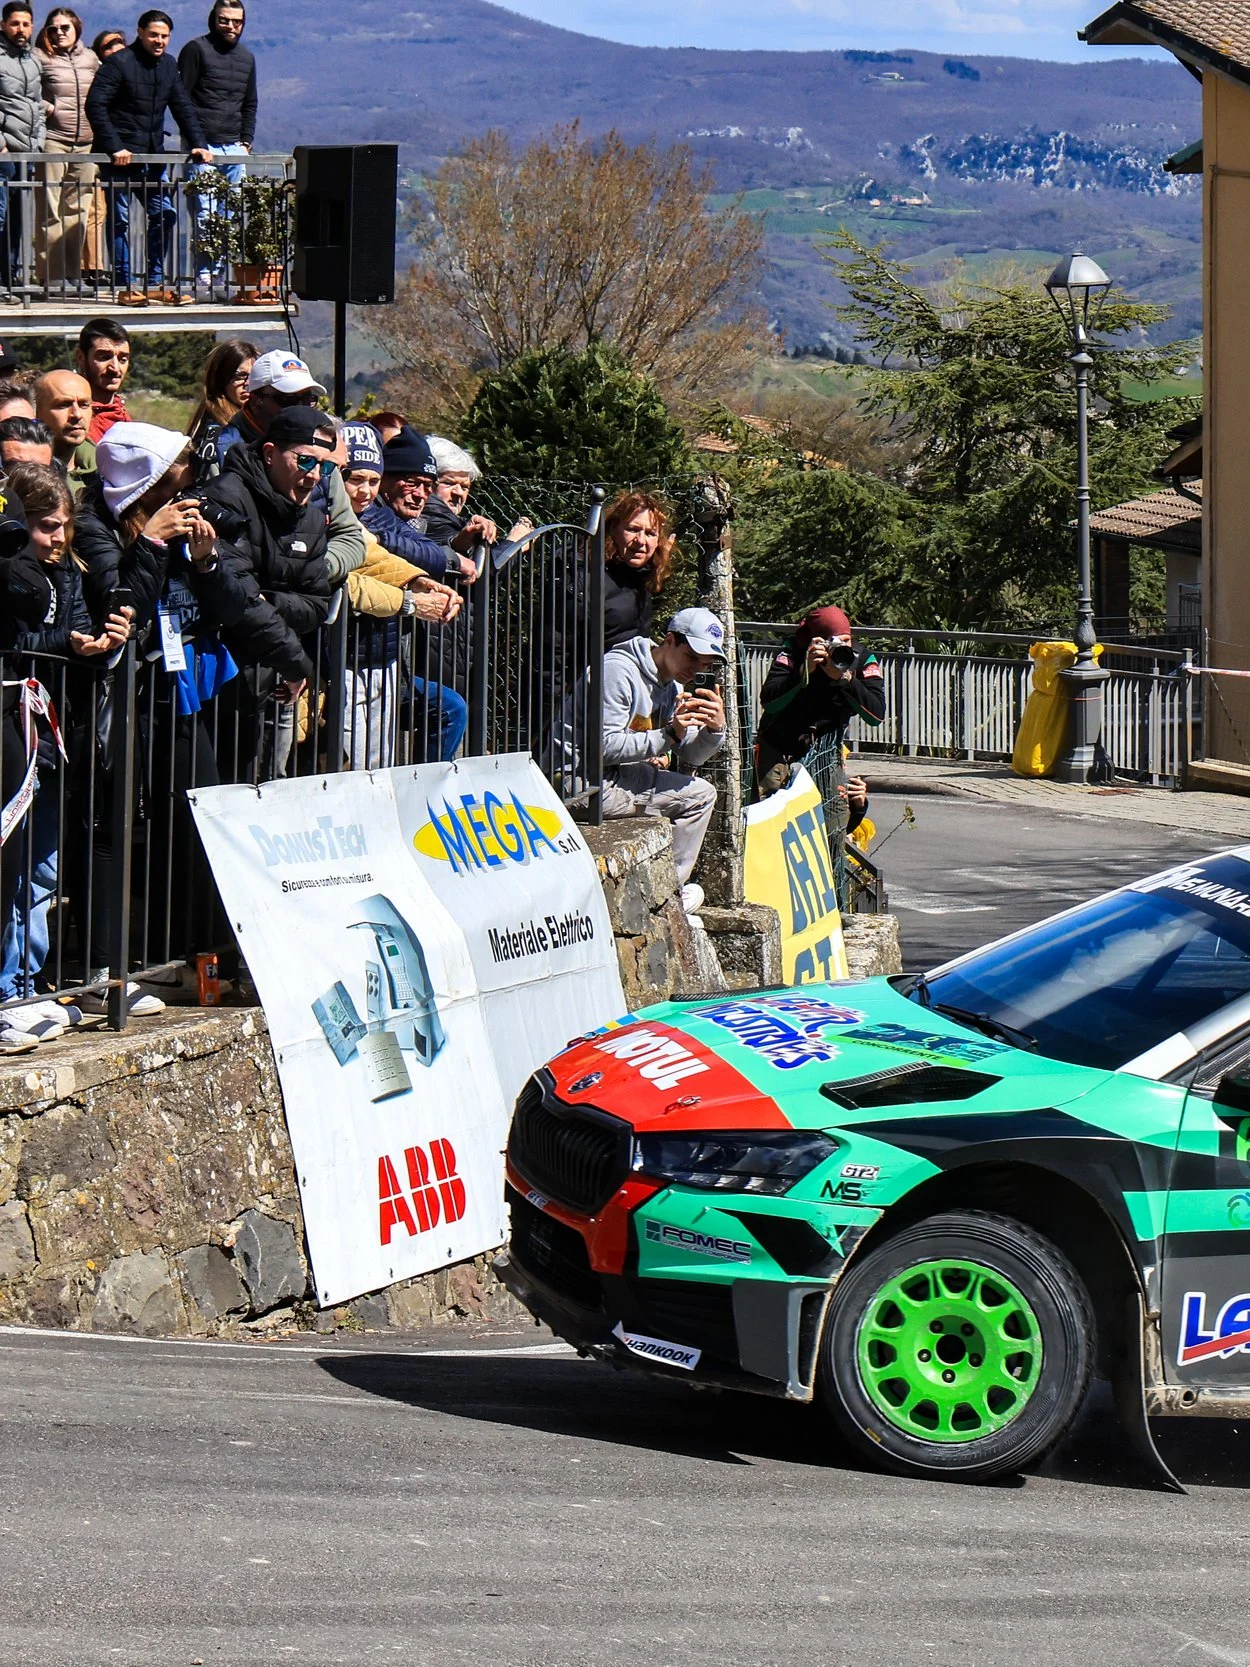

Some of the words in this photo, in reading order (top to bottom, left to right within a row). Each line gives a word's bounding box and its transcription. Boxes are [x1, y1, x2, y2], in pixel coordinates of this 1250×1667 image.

[354, 450, 381, 465] SIDE
[427, 786, 560, 874] MEGA
[488, 920, 549, 963] Materiale
[544, 909, 594, 950] Elettrico
[593, 1029, 711, 1091] MOTUL
[851, 1039, 944, 1061] CONCORRENTE
[378, 1138, 466, 1245] ABB
[820, 1180, 863, 1201] MS
[663, 1226, 752, 1257] FOMEC
